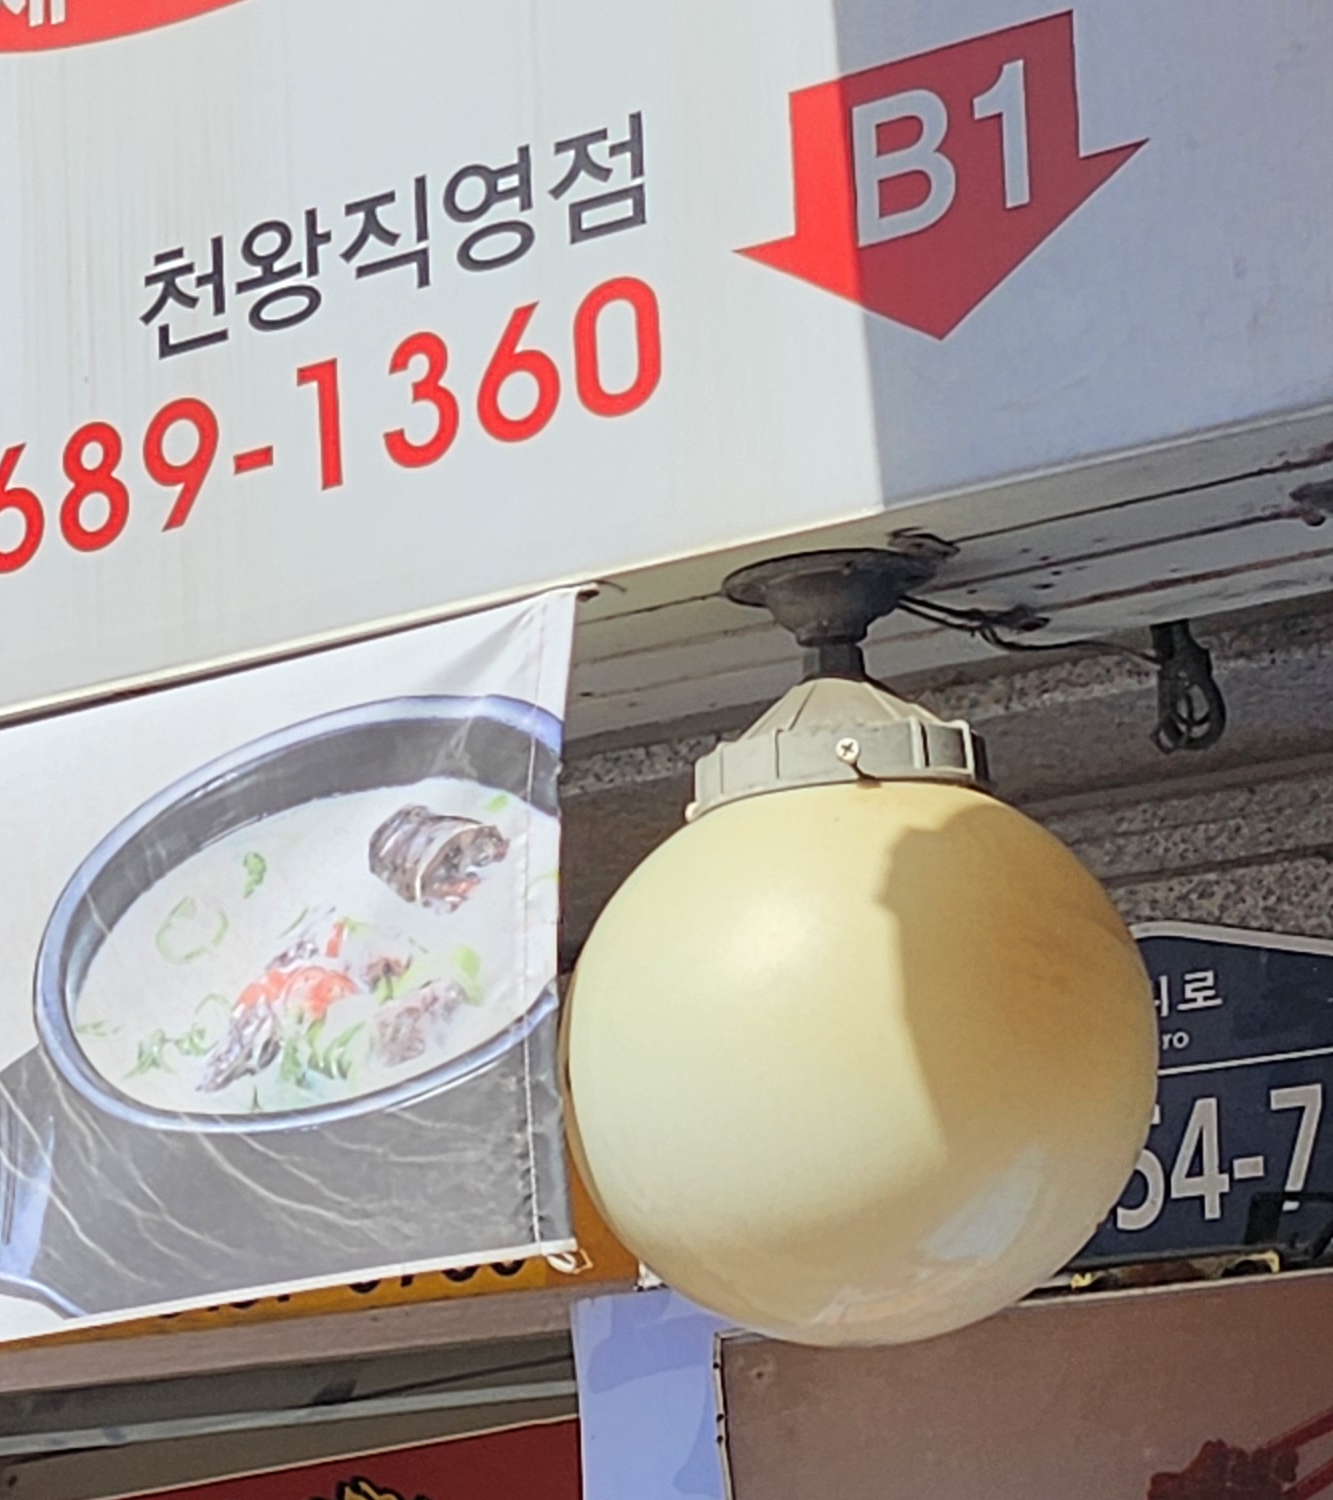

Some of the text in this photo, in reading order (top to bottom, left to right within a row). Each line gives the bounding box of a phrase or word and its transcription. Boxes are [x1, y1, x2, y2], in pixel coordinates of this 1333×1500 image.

[139, 111, 650, 360] 천왕직영점
[849, 57, 1041, 250] B1
[1159, 1030, 1191, 1050] ro
